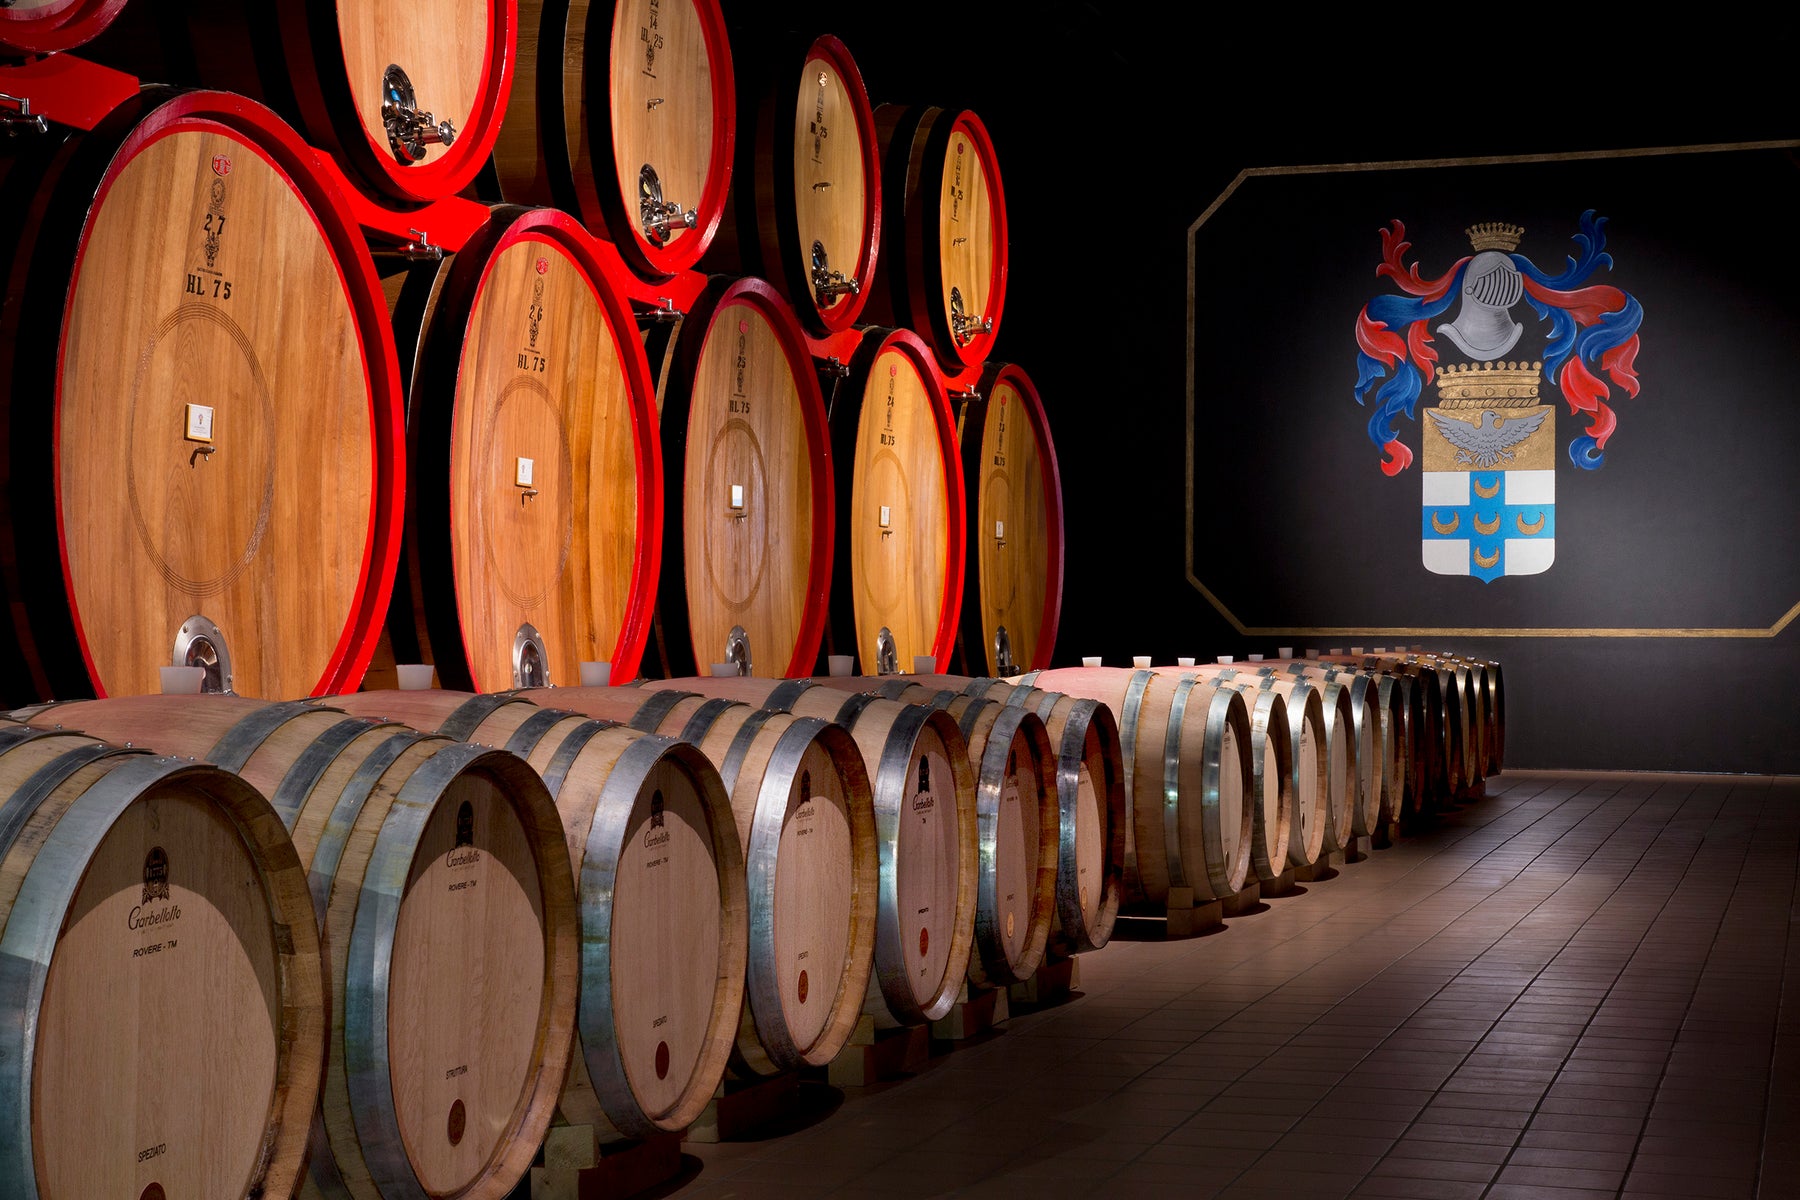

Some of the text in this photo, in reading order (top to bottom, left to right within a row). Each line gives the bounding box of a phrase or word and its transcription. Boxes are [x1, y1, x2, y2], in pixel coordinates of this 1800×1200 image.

[653, 33, 664, 49] 25
[203, 213, 226, 236] 27
[186, 273, 232, 300] HL 75
[528, 304, 543, 322] 26
[517, 353, 546, 373] HL 75
[741, 402, 750, 414] 75
[128, 905, 181, 931] Garbellotto
[133, 943, 162, 958] ROVERE
[167, 939, 178, 950] TM
[138, 1143, 167, 1163] SPEZIATO
